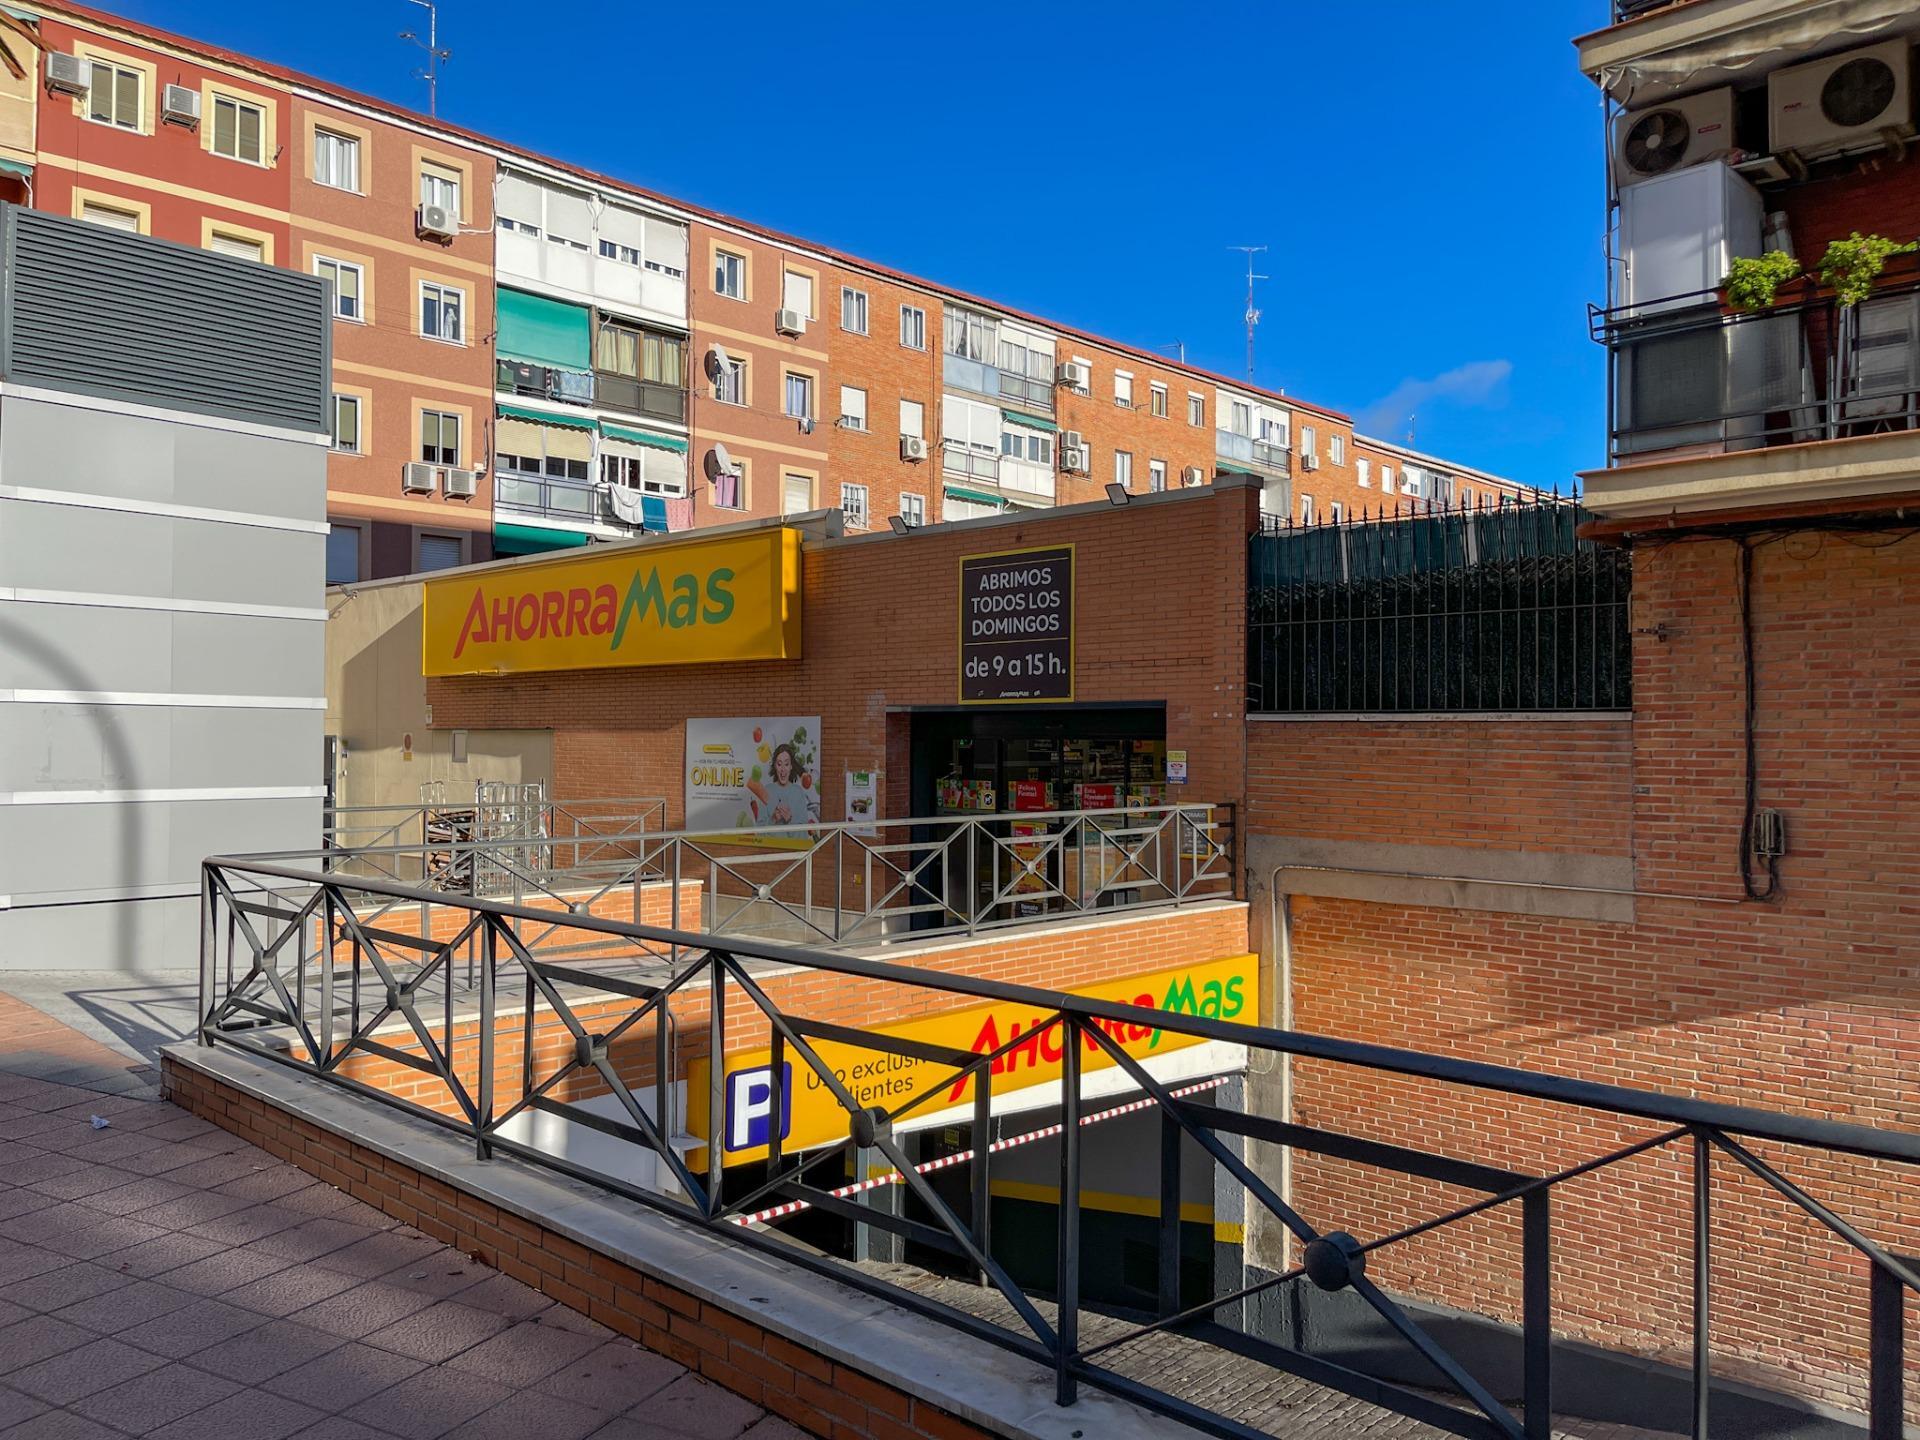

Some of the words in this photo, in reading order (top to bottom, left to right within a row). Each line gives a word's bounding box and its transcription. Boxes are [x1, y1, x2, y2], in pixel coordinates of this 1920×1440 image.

[979, 567, 1052, 591] ABRIMOS
[971, 593, 1026, 614] TODOS
[1029, 590, 1060, 609] LOS
[972, 613, 1060, 636] DOMINGOS
[965, 656, 989, 678] de
[992, 655, 1005, 677] 9
[1008, 659, 1021, 676] a
[1025, 653, 1044, 676] 15
[1049, 652, 1067, 675] h.
[690, 766, 745, 787] ONLINE
[806, 1069, 846, 1090] Uo
[733, 1069, 773, 1147] P
